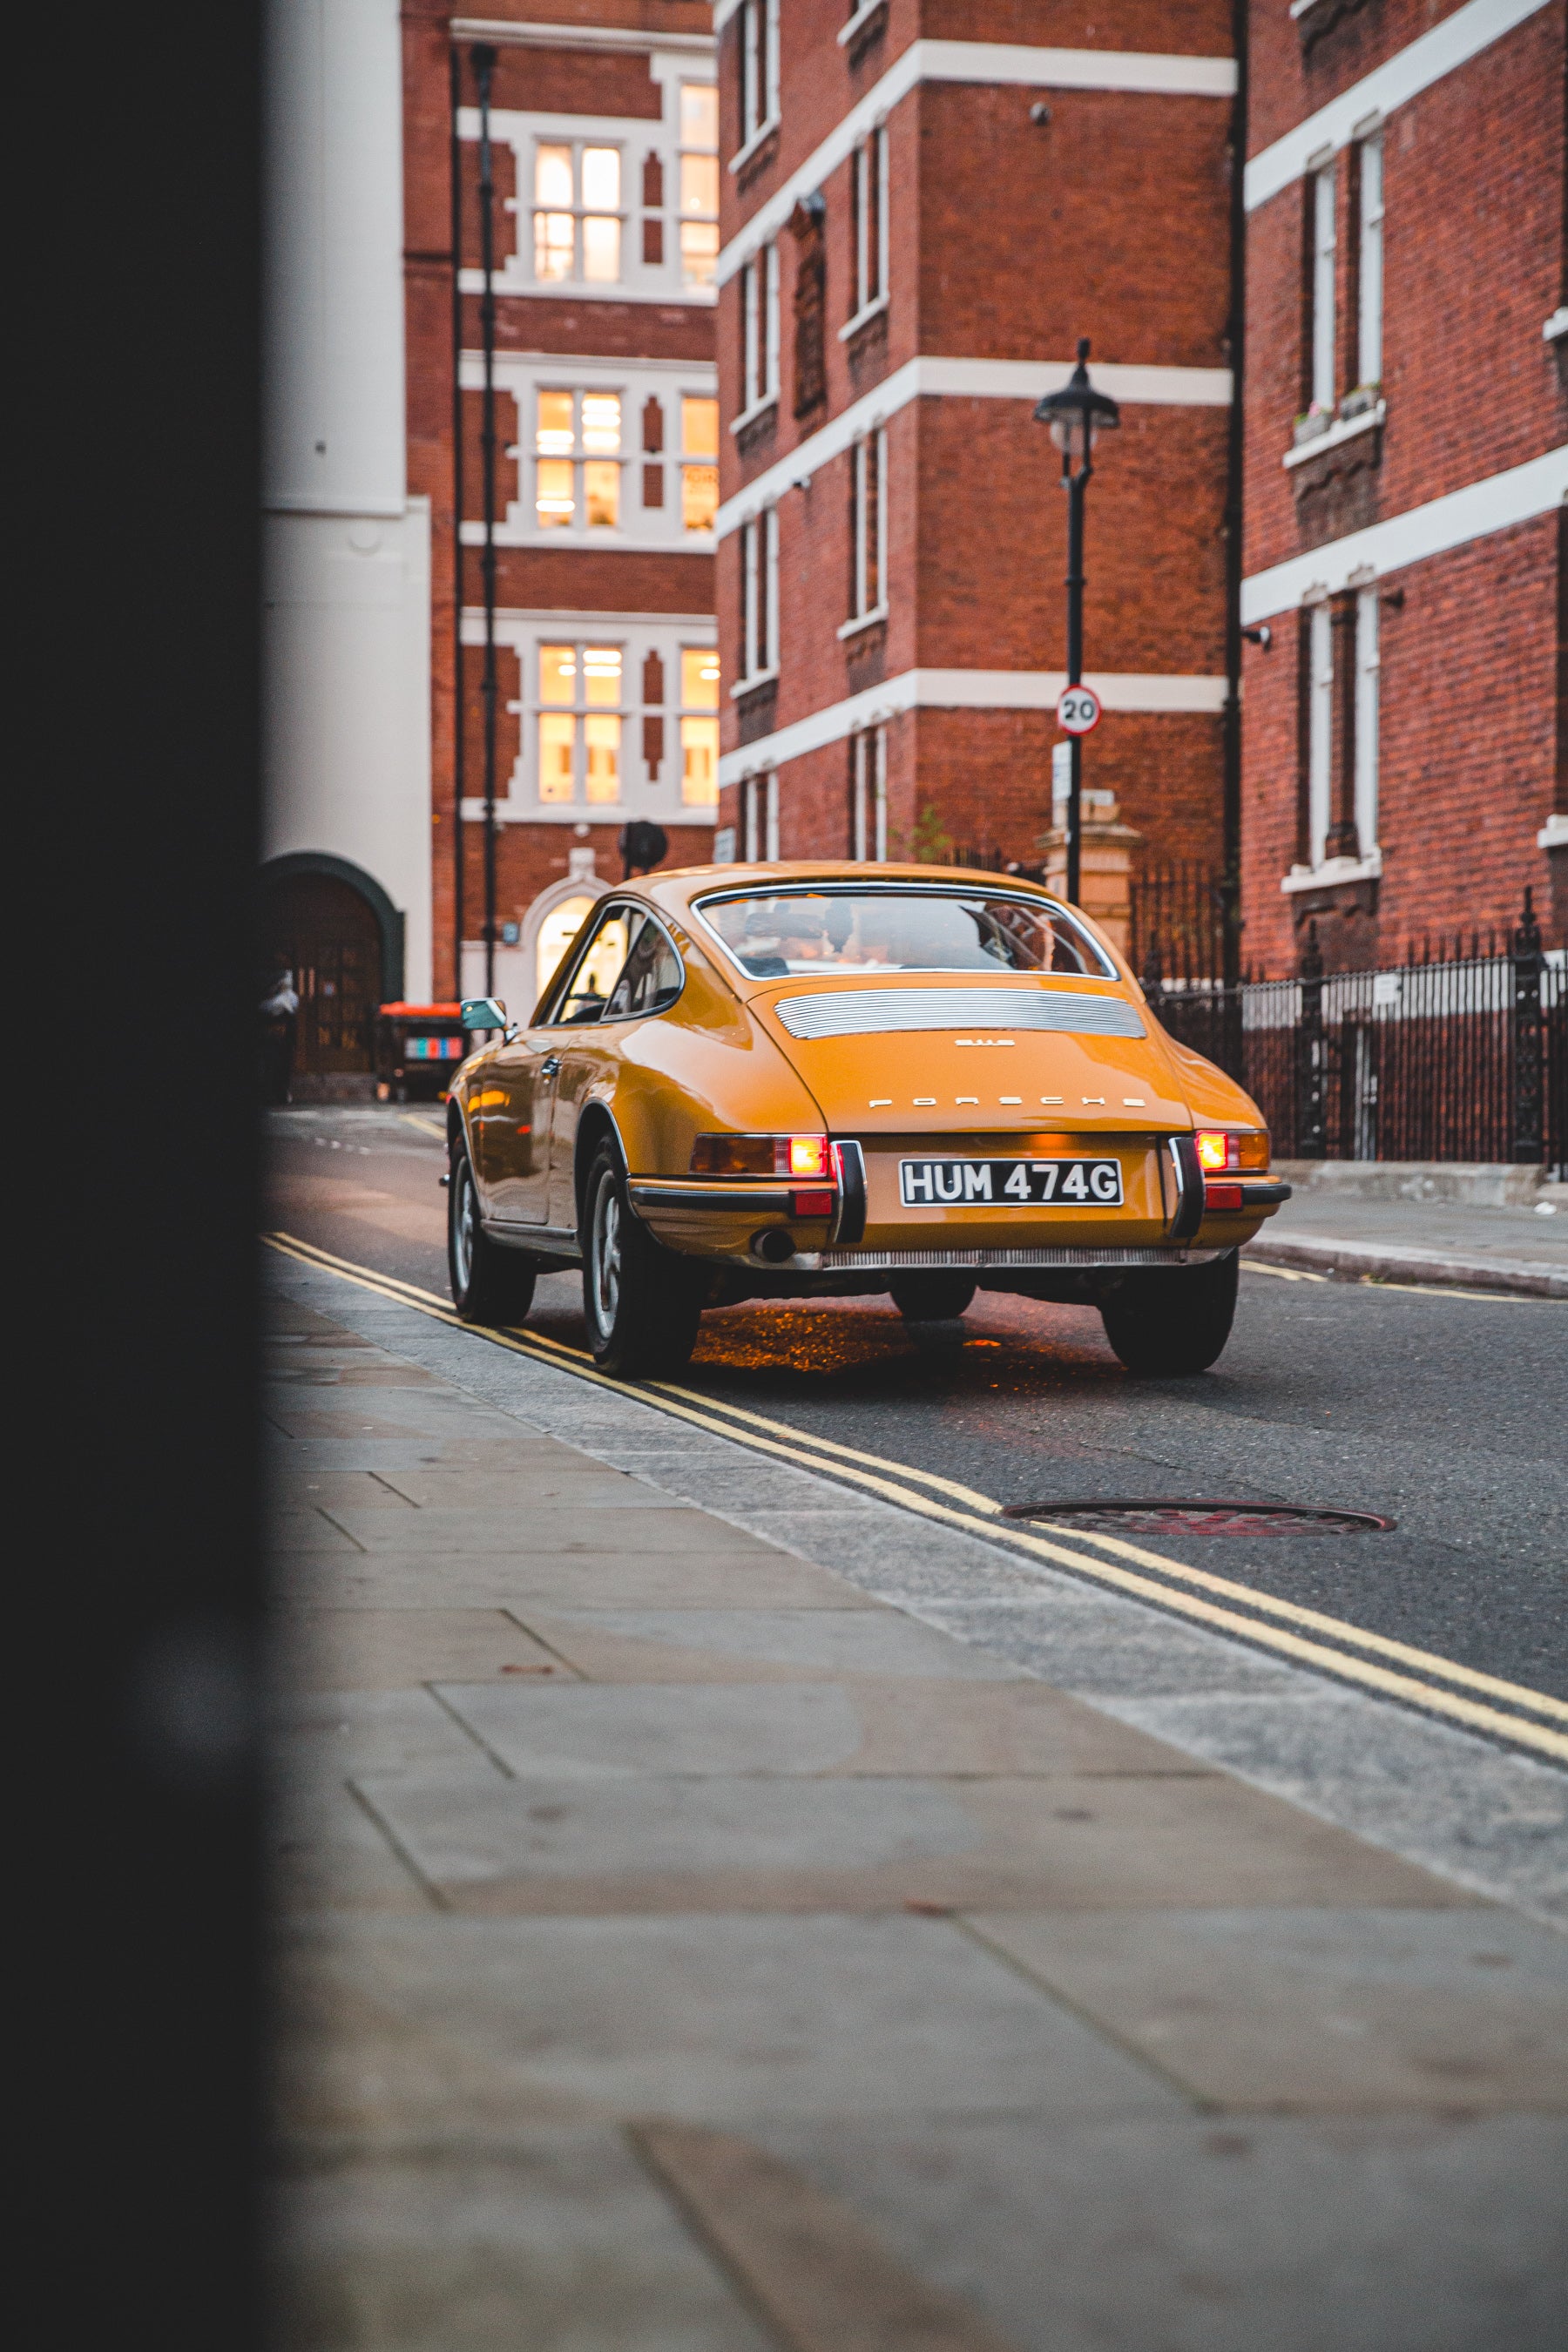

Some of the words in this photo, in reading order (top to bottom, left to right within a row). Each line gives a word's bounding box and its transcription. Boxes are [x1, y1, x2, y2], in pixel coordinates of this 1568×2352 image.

[1064, 700, 1096, 720] 20
[868, 1096, 1146, 1108] PORSCHE
[904, 1164, 993, 1200] HUM
[1004, 1163, 1118, 1200] 474G
